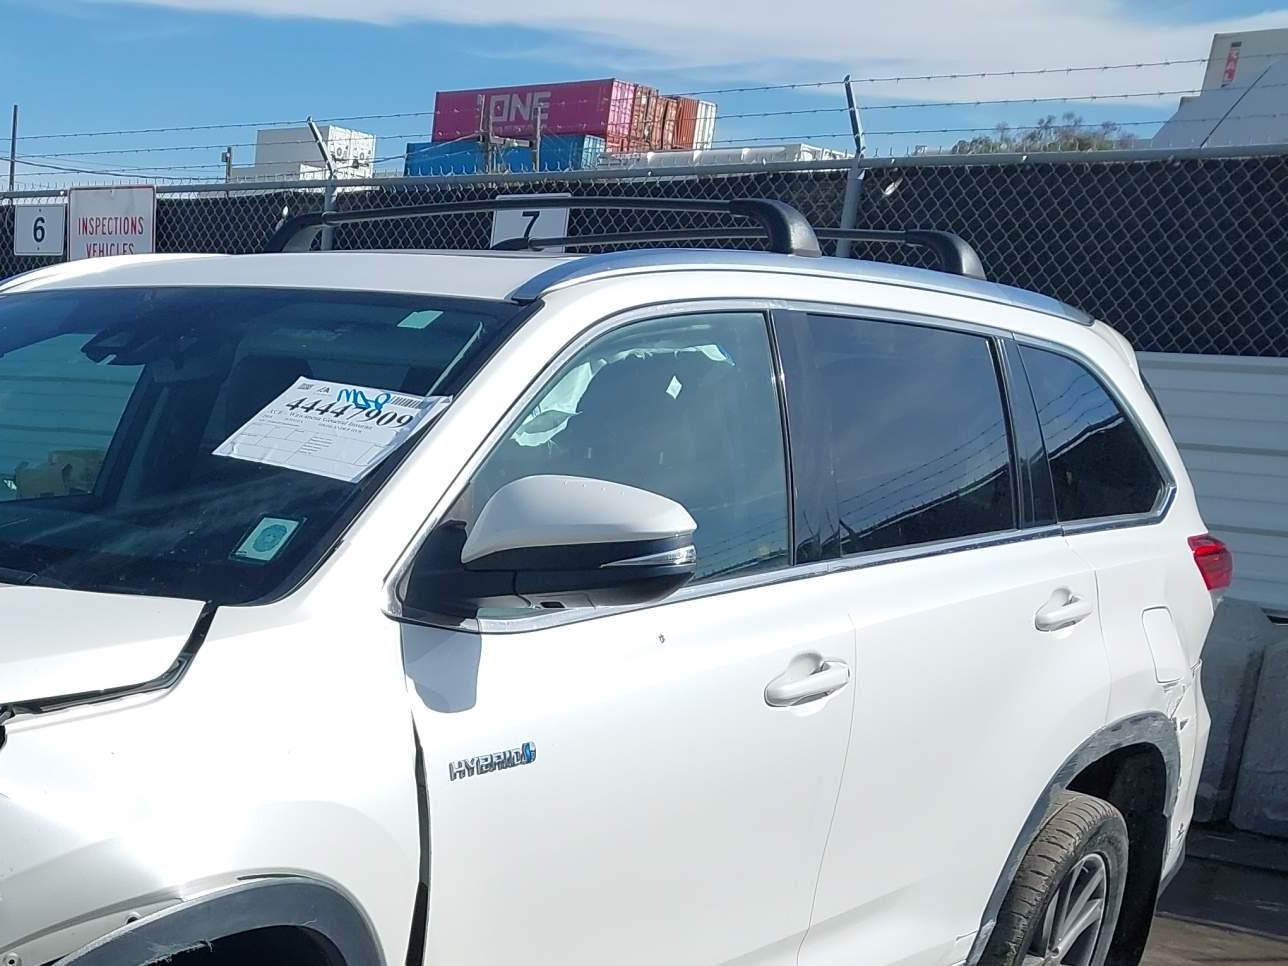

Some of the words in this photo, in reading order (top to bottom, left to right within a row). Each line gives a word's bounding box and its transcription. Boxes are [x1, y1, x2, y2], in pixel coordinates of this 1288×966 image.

[490, 91, 552, 122] ONE
[33, 216, 46, 243] 6
[77, 216, 145, 236] INSPECTIONS
[522, 211, 540, 241] 7
[286, 397, 414, 429] 44447909
[448, 747, 525, 782] HYBRID
